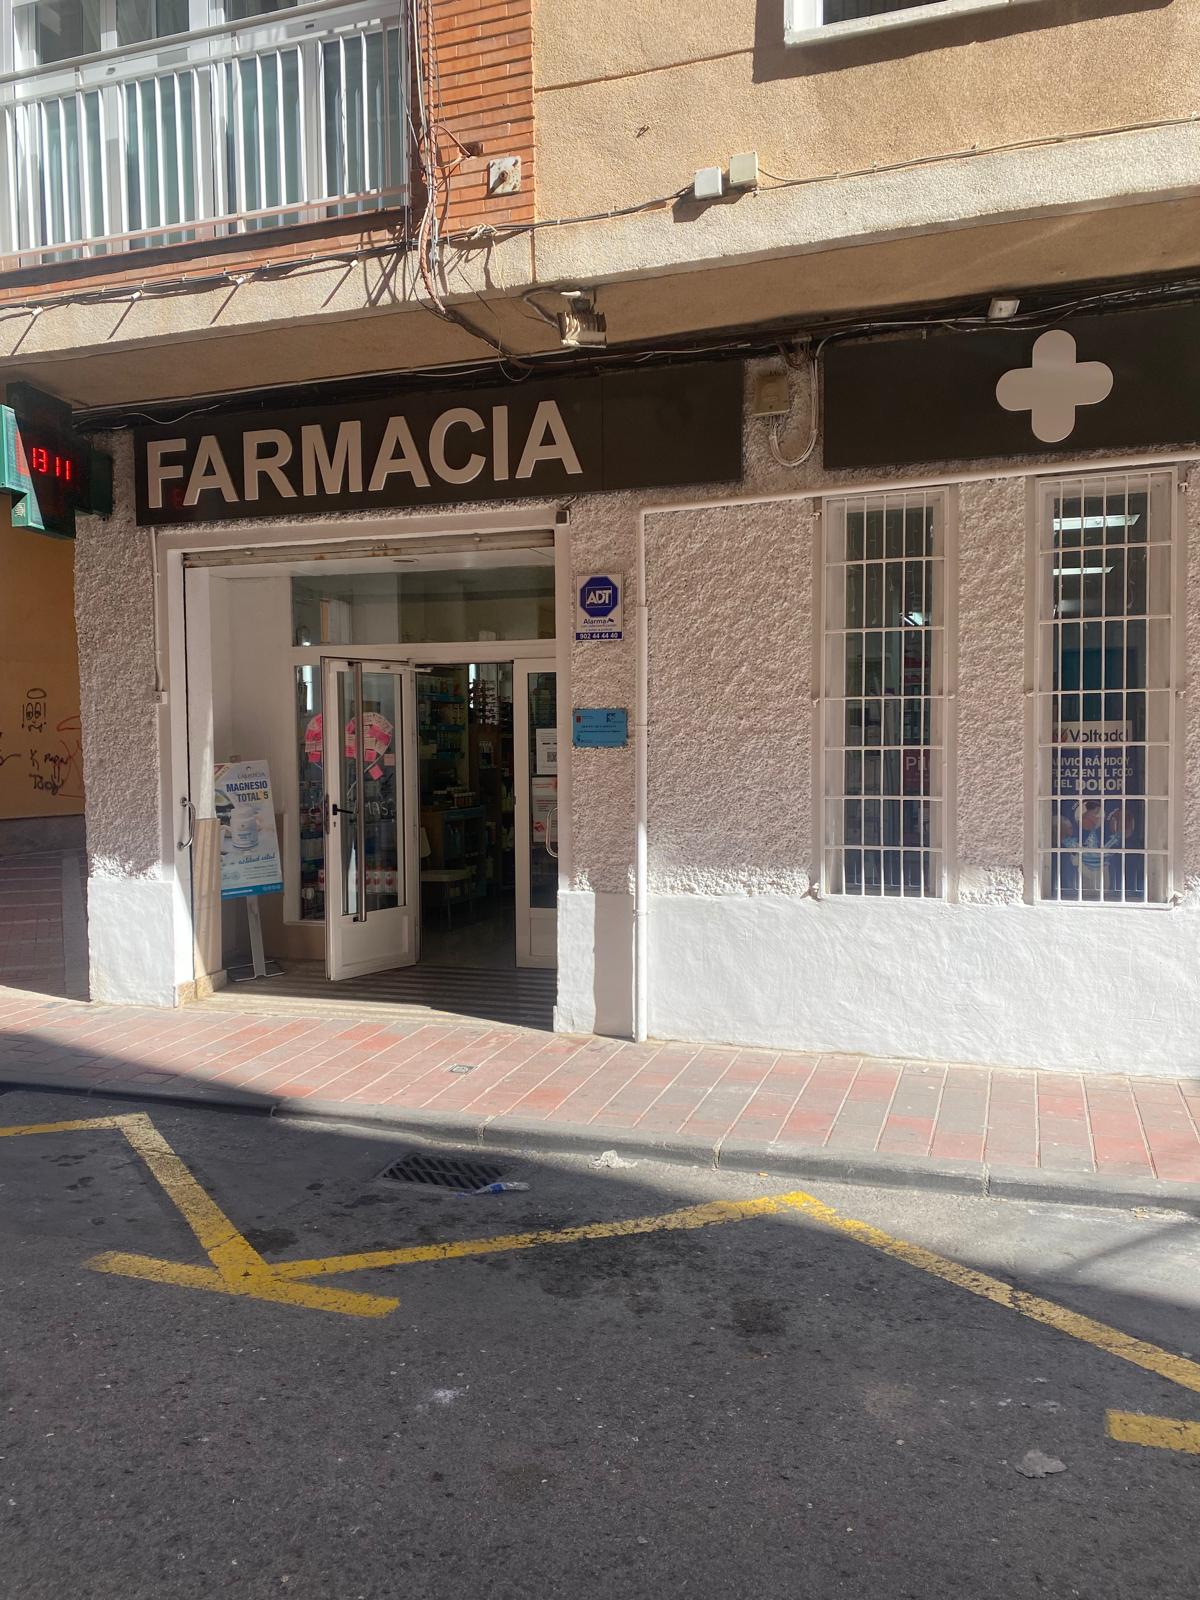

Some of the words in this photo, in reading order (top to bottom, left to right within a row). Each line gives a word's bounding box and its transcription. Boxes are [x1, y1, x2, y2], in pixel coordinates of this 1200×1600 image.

[146, 400, 583, 510] FARMACIA
[586, 589, 612, 604] ADT
[583, 617, 608, 625] Alarma
[226, 780, 268, 793] MAGNESIO
[238, 791, 261, 803] TOTAL
[263, 791, 269, 800] 5
